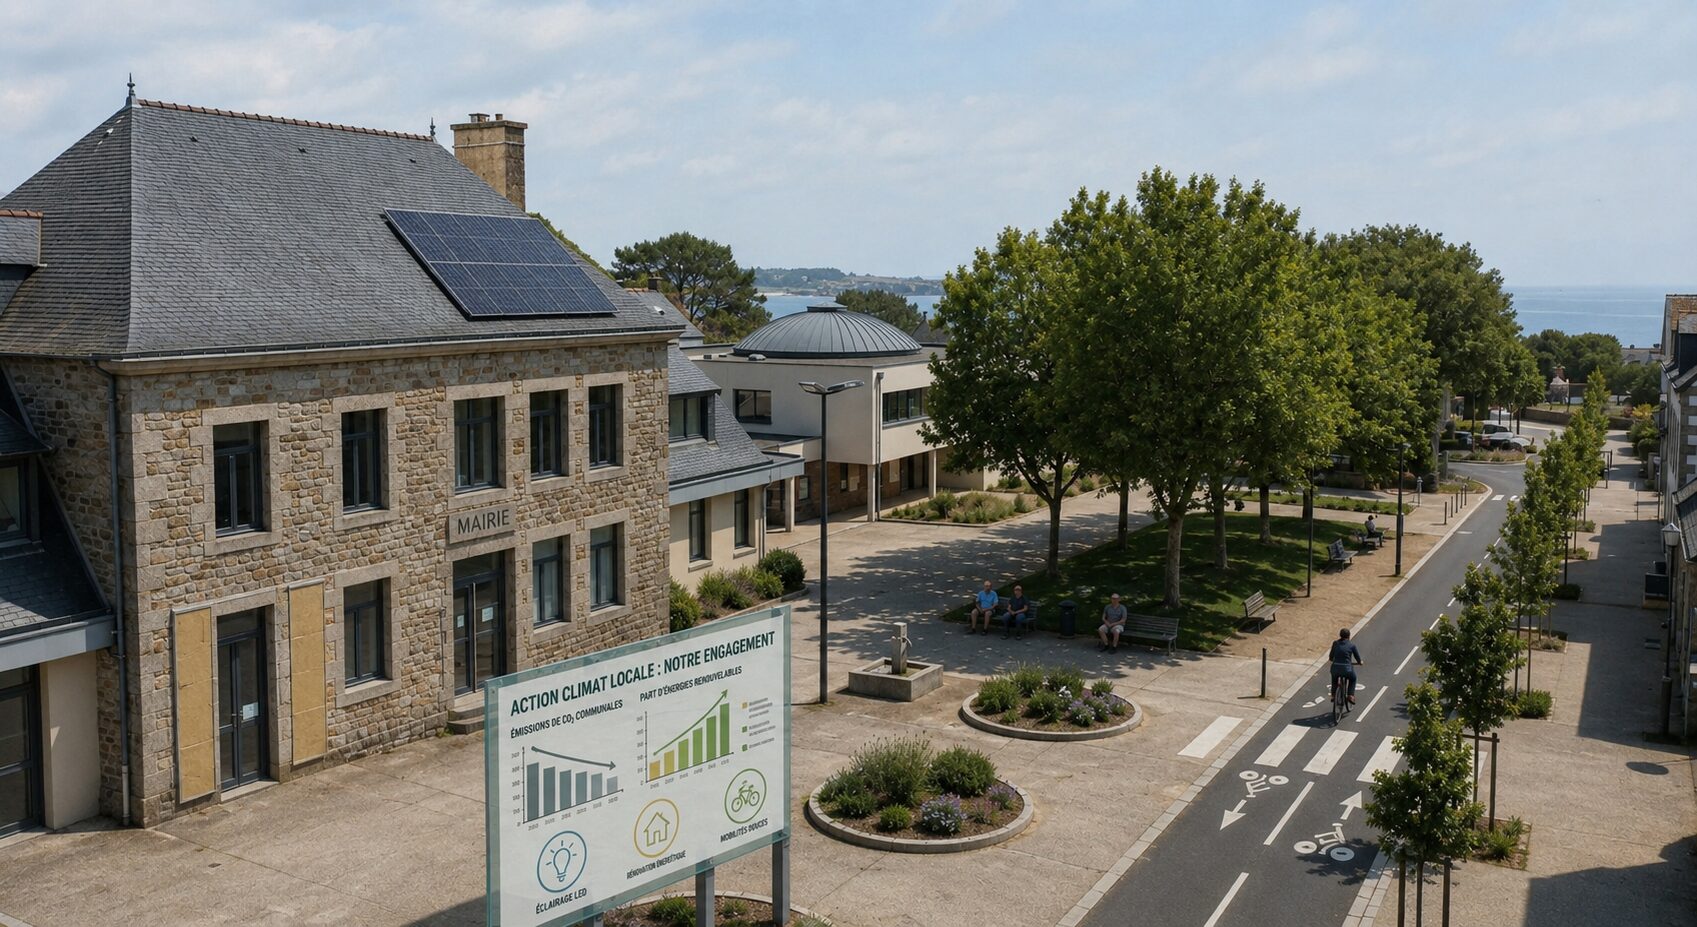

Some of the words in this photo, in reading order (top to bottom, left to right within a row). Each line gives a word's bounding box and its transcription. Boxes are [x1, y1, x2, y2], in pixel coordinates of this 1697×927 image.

[457, 509, 510, 535] MAIRIE
[510, 689, 559, 717] ACTION
[562, 675, 608, 702] CLIMAT
[610, 662, 655, 689] LOCALE
[657, 664, 661, 676] :
[664, 650, 702, 674] NOTRE
[703, 630, 776, 664] ENGAGEMENT
[639, 689, 658, 702] PART
[510, 719, 551, 739] ÉMISSIONS
[551, 716, 561, 728] DE
[575, 699, 624, 721] COMMUNALES
[535, 892, 573, 915] ÉCLAIRAGE
[574, 887, 588, 900] LED
